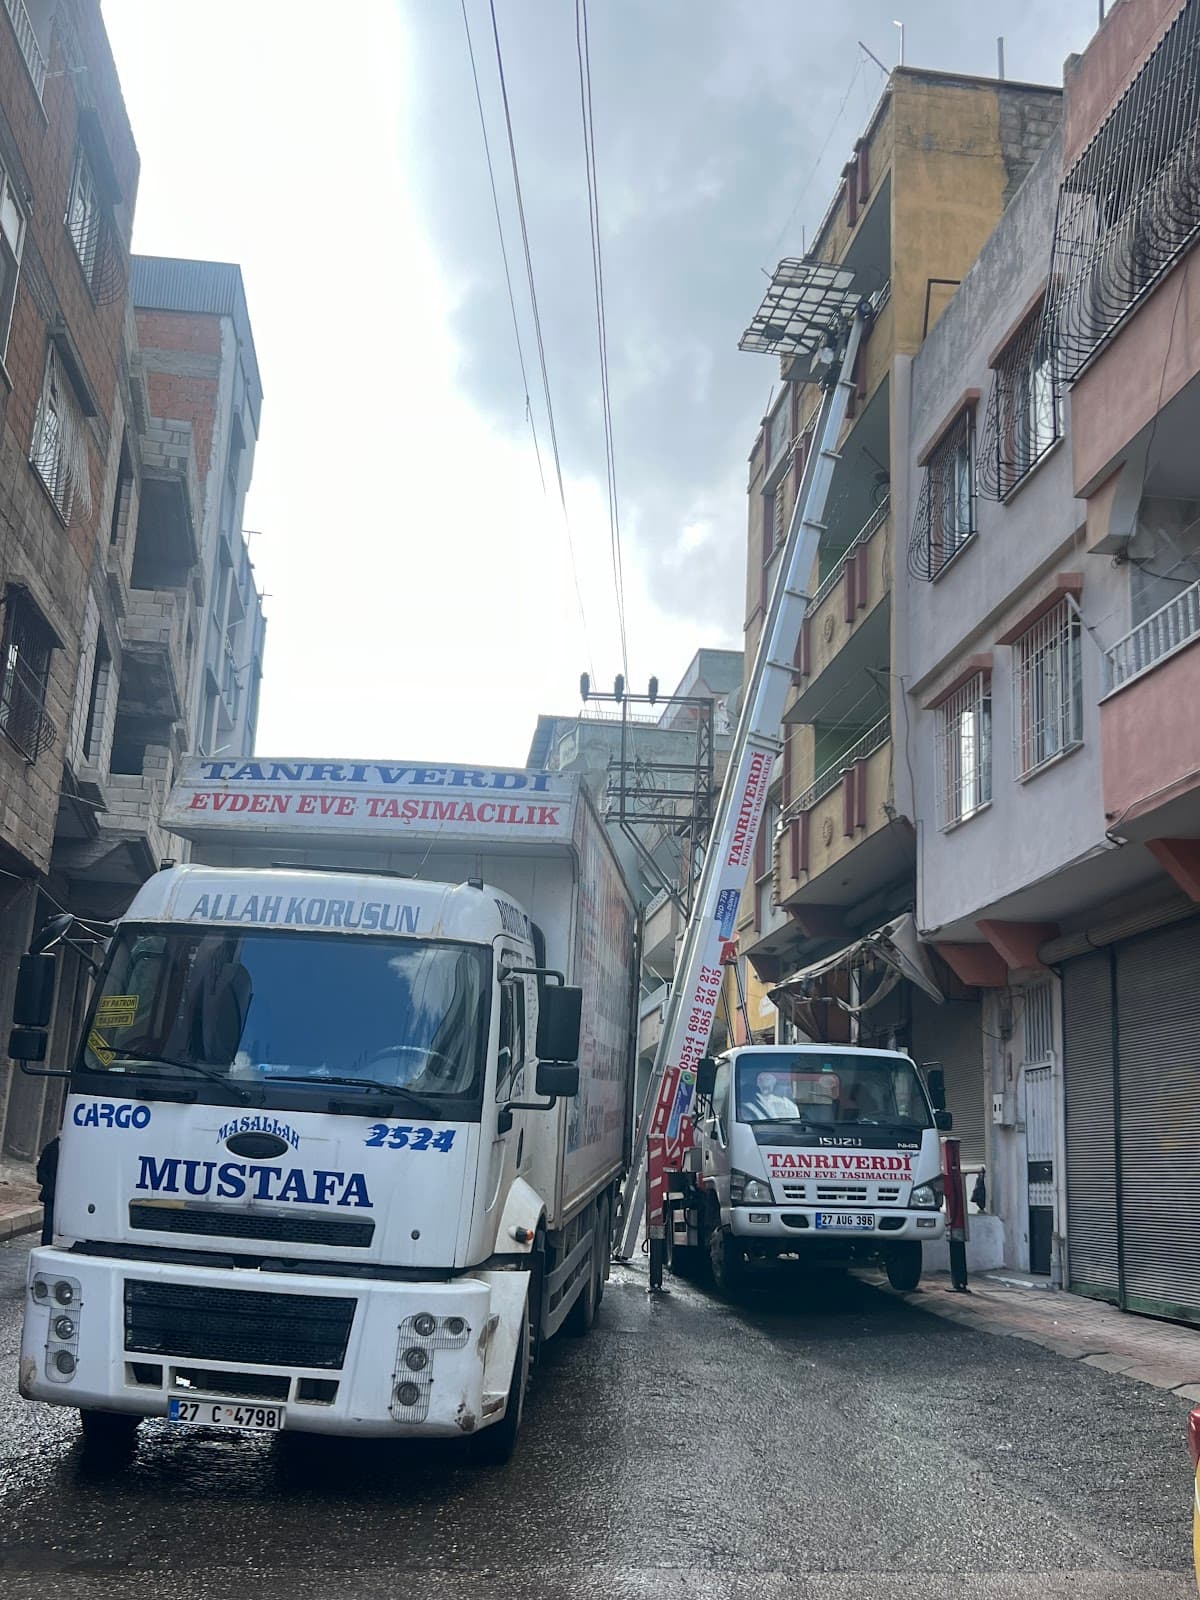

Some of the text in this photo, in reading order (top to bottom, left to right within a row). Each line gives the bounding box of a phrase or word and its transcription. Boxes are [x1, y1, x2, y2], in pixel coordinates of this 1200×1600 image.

[189, 792, 560, 825] EVDEN EVE TAŞIMACILIK
[728, 752, 765, 866] TANRIVERDİ
[741, 835, 754, 866] EVDEN
[750, 814, 758, 833] EVE
[190, 894, 421, 933] ALLAH KORUSUN
[710, 969, 722, 986] 95
[705, 989, 717, 1006] 26
[679, 965, 711, 1070] 0554 694 27 27
[698, 1010, 712, 1035] 385
[73, 1103, 151, 1129] CARGO
[216, 1115, 300, 1151] MASALLAH
[365, 1123, 456, 1153] 2524
[818, 1136, 862, 1146] ISUZU
[767, 1153, 912, 1171] TANRIVERDİ
[772, 1170, 811, 1178] EVDEN
[814, 1171, 837, 1179] EVE
[135, 1156, 374, 1208] MUSTAFA
[822, 1214, 873, 1226] 27 AUG 396
[179, 1402, 200, 1421] 27
[212, 1405, 222, 1423] C
[233, 1406, 276, 1428] 4798
